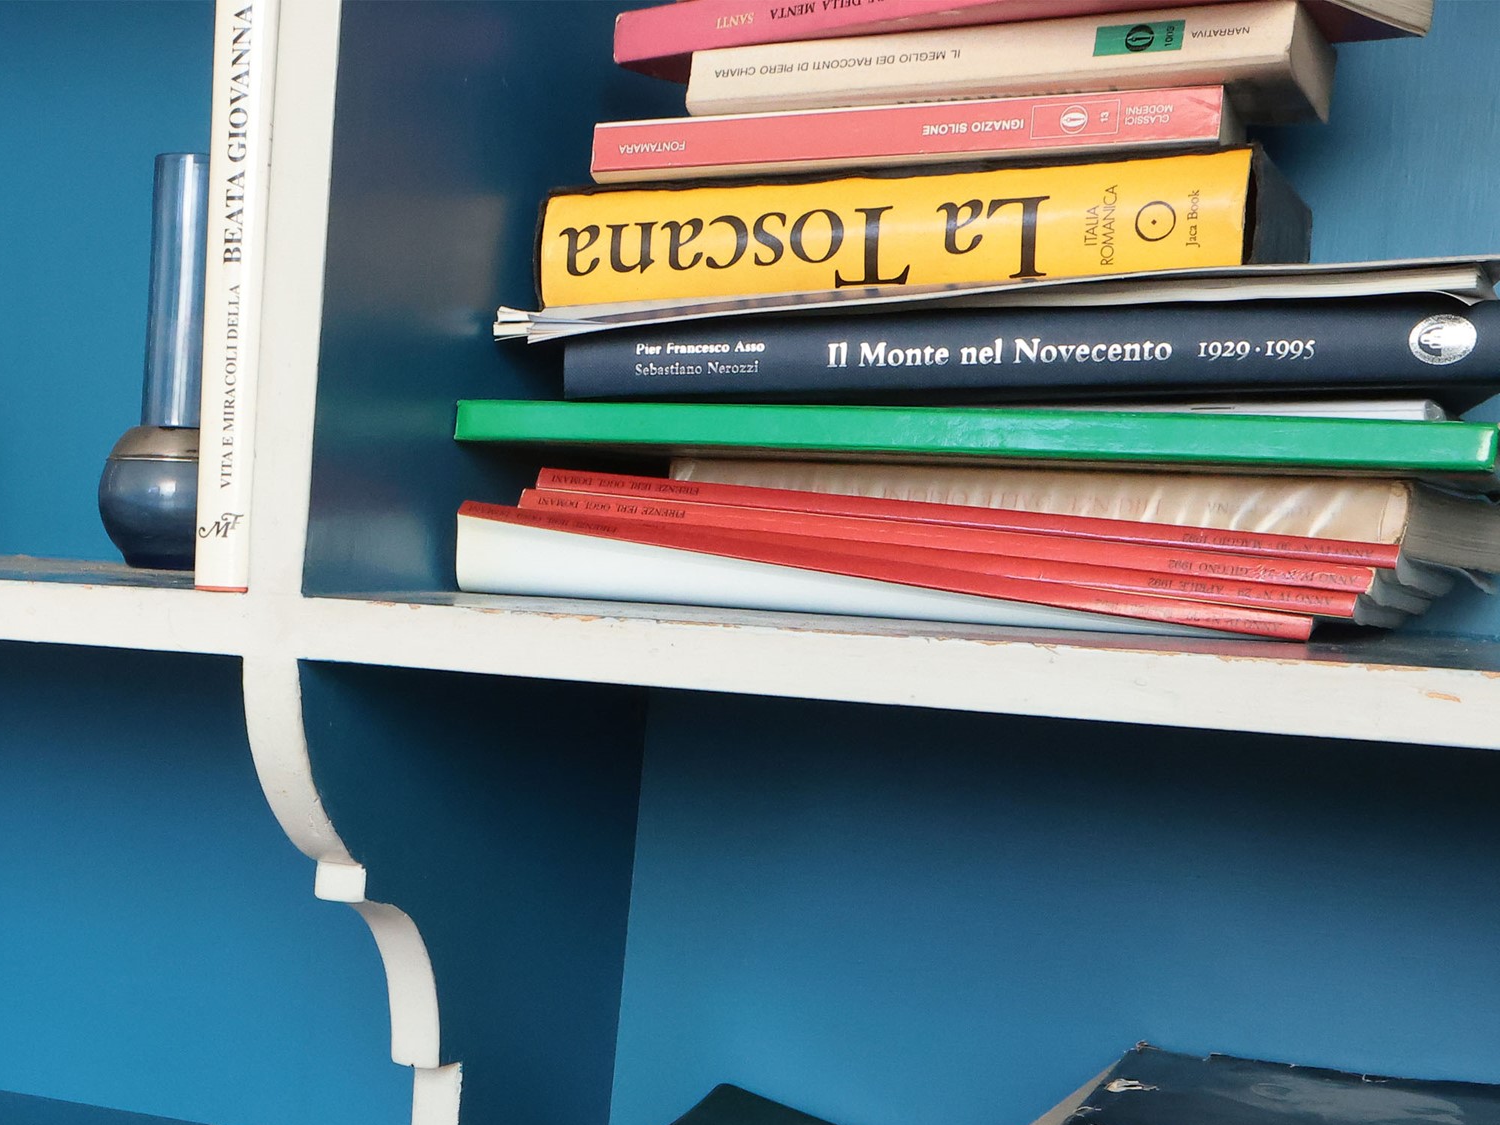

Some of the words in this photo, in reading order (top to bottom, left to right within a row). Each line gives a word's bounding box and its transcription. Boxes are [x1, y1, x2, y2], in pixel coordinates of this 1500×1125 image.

[770, 1, 815, 20] MENTA
[716, 12, 754, 29] SANTI
[1191, 26, 1250, 39] NARRATIVA
[875, 54, 895, 64] DEI
[899, 50, 946, 62] MEGLIO
[951, 49, 961, 59] IL
[760, 63, 793, 75] PIERO
[797, 62, 810, 71] DI
[811, 56, 872, 69] RACCONTI
[714, 66, 756, 78] CHIARA
[227, 5, 254, 163] GIOVANNA
[1125, 104, 1173, 116] MODERNI
[972, 119, 1025, 132] IGNAZIO
[1124, 114, 1170, 125] CLASSICI
[922, 122, 968, 136] SILONE
[618, 141, 686, 154] FONTAMARA
[1187, 189, 1200, 220] Book
[223, 170, 246, 265] BEATA
[1100, 184, 1118, 265] ROMANICA
[1084, 205, 1099, 246] ITALIA
[936, 194, 1050, 279] La
[1185, 224, 1200, 247] Jaca
[559, 205, 911, 288] Toscana
[227, 284, 241, 340] DELLA
[635, 343, 662, 355] Pier
[666, 342, 730, 355] Francesco
[734, 341, 766, 353] Asso
[827, 342, 848, 368] Il
[858, 342, 950, 367] Monte
[961, 338, 1002, 365] nel
[1012, 338, 1172, 364] Novecento
[634, 362, 702, 376] Sebastiano
[706, 360, 759, 375] Nerozzi
[223, 346, 238, 432] MIRACOLI
[222, 437, 234, 447] E
[220, 453, 233, 489] VITA
[551, 474, 592, 485] DOMANI
[538, 497, 579, 509] DOMANI
[641, 506, 686, 518] FIRENZE
